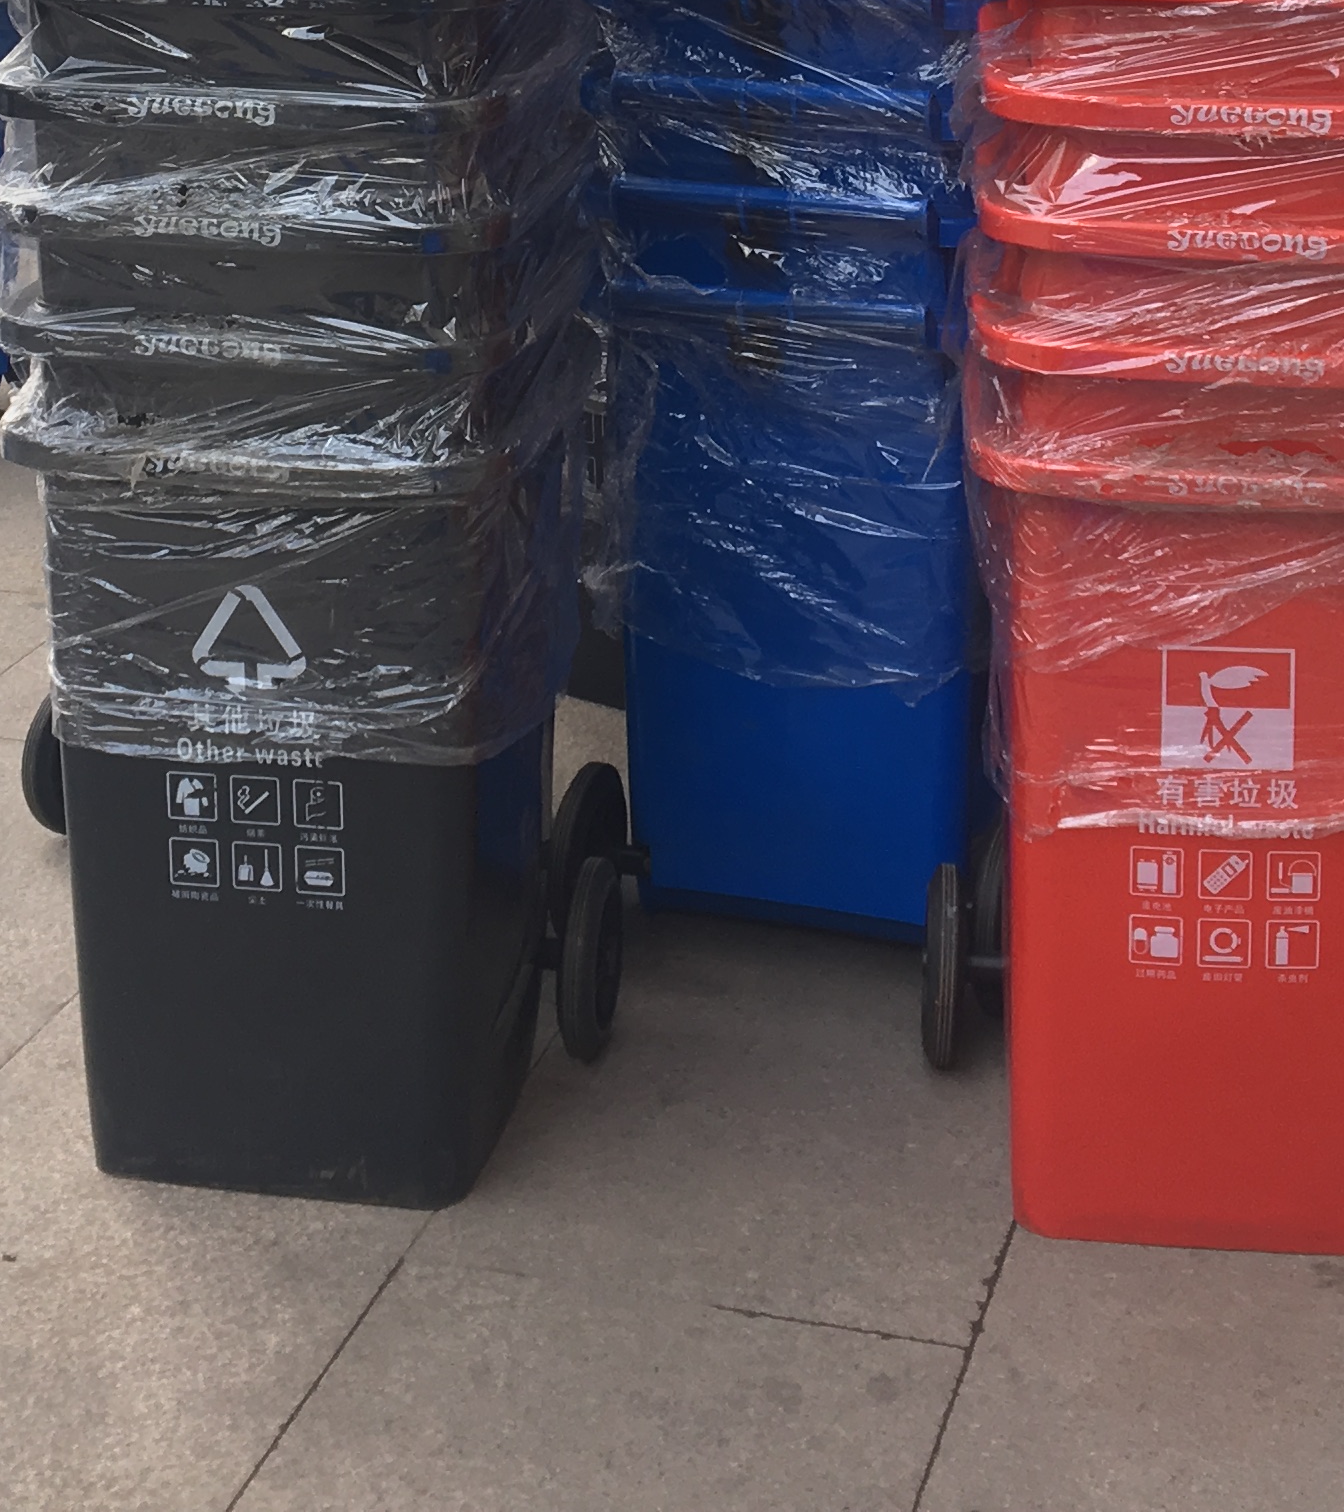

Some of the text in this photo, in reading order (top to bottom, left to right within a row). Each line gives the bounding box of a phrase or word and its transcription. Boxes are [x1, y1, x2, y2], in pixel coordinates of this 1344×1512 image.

[127, 96, 276, 126] yuetong
[133, 214, 283, 247] yuetong
[177, 738, 245, 761] Other
[1156, 774, 1299, 810] 有害垃圾
